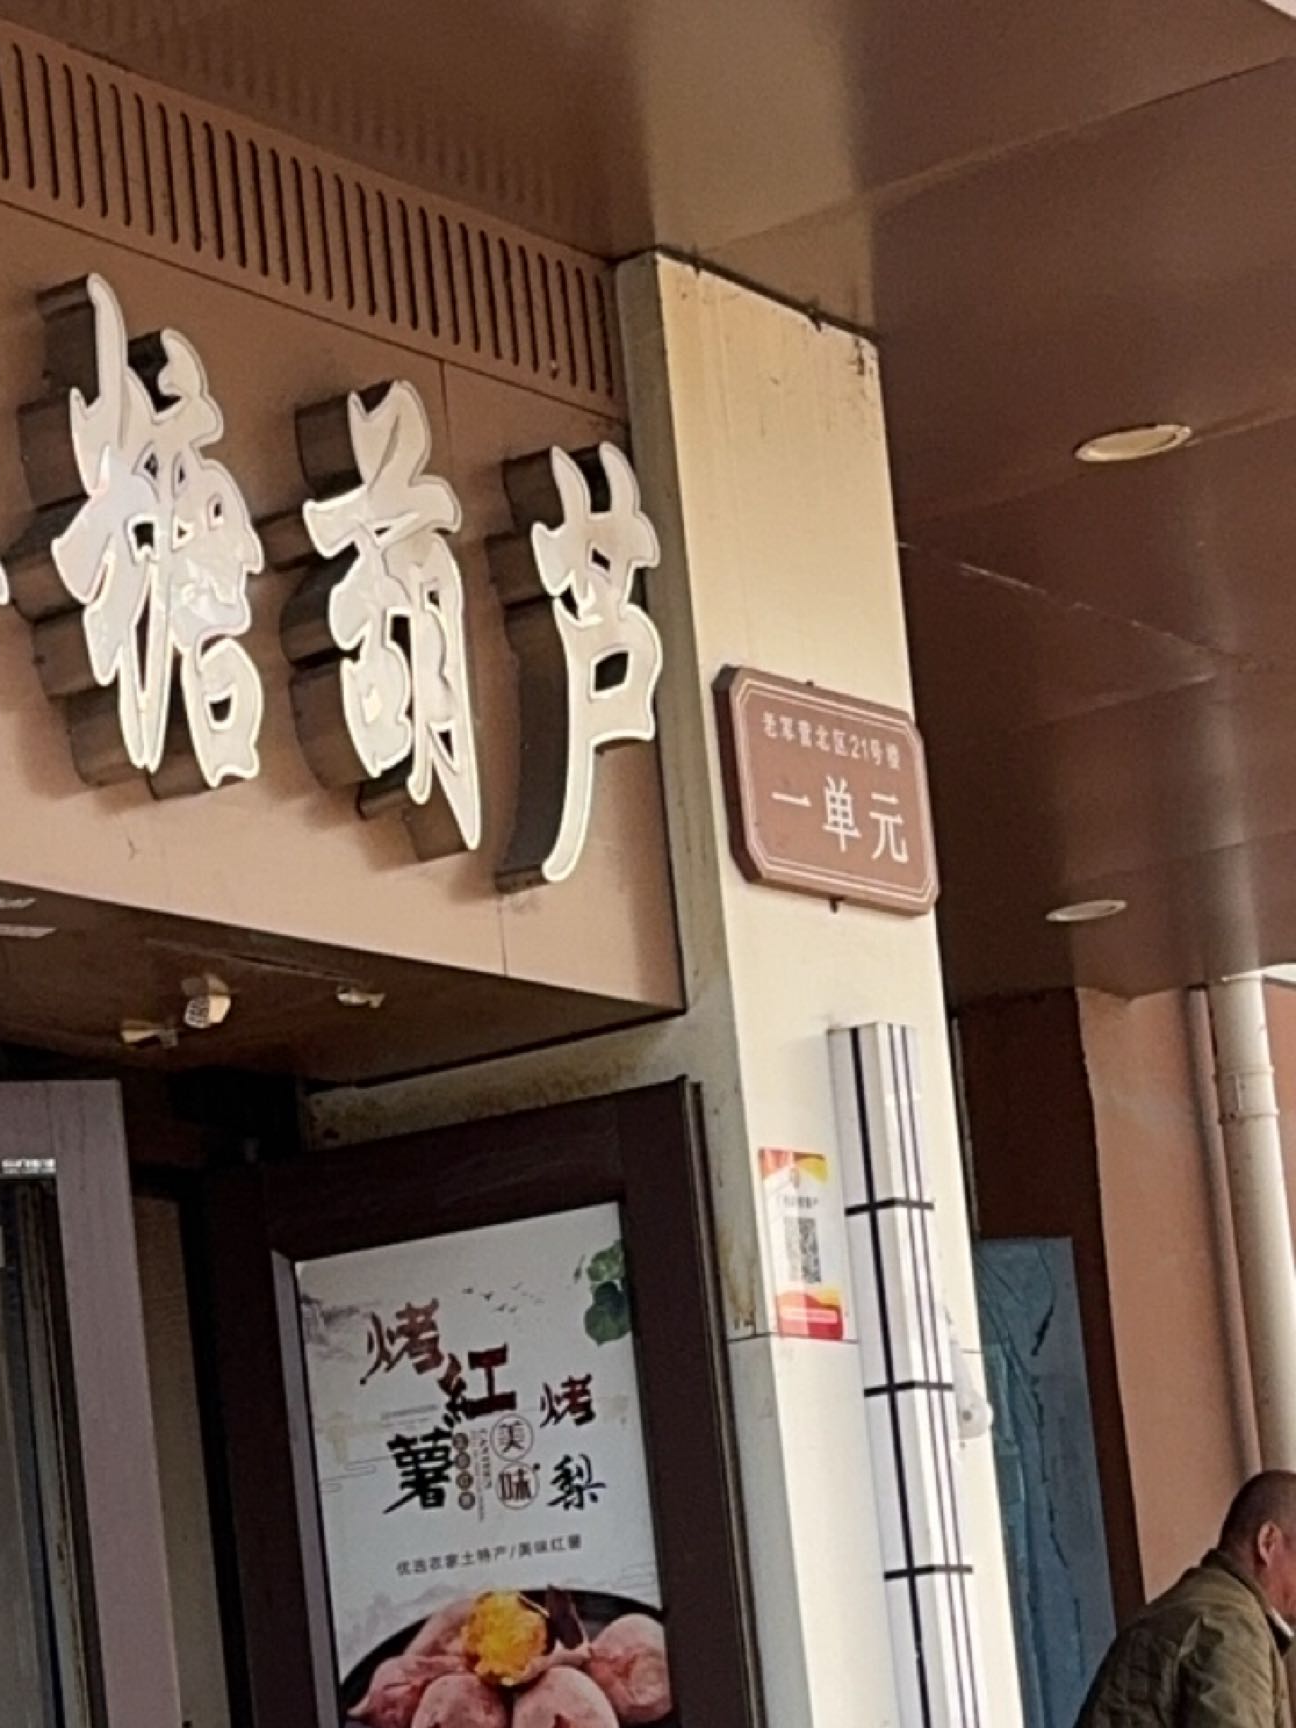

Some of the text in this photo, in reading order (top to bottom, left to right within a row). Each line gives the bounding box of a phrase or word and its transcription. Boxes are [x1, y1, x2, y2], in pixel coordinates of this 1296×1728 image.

[771, 775, 910, 865] 一单元
[360, 1297, 518, 1515] 烤红薯
[497, 1419, 534, 1502] 美味
[539, 1374, 607, 1512] 烤梨
